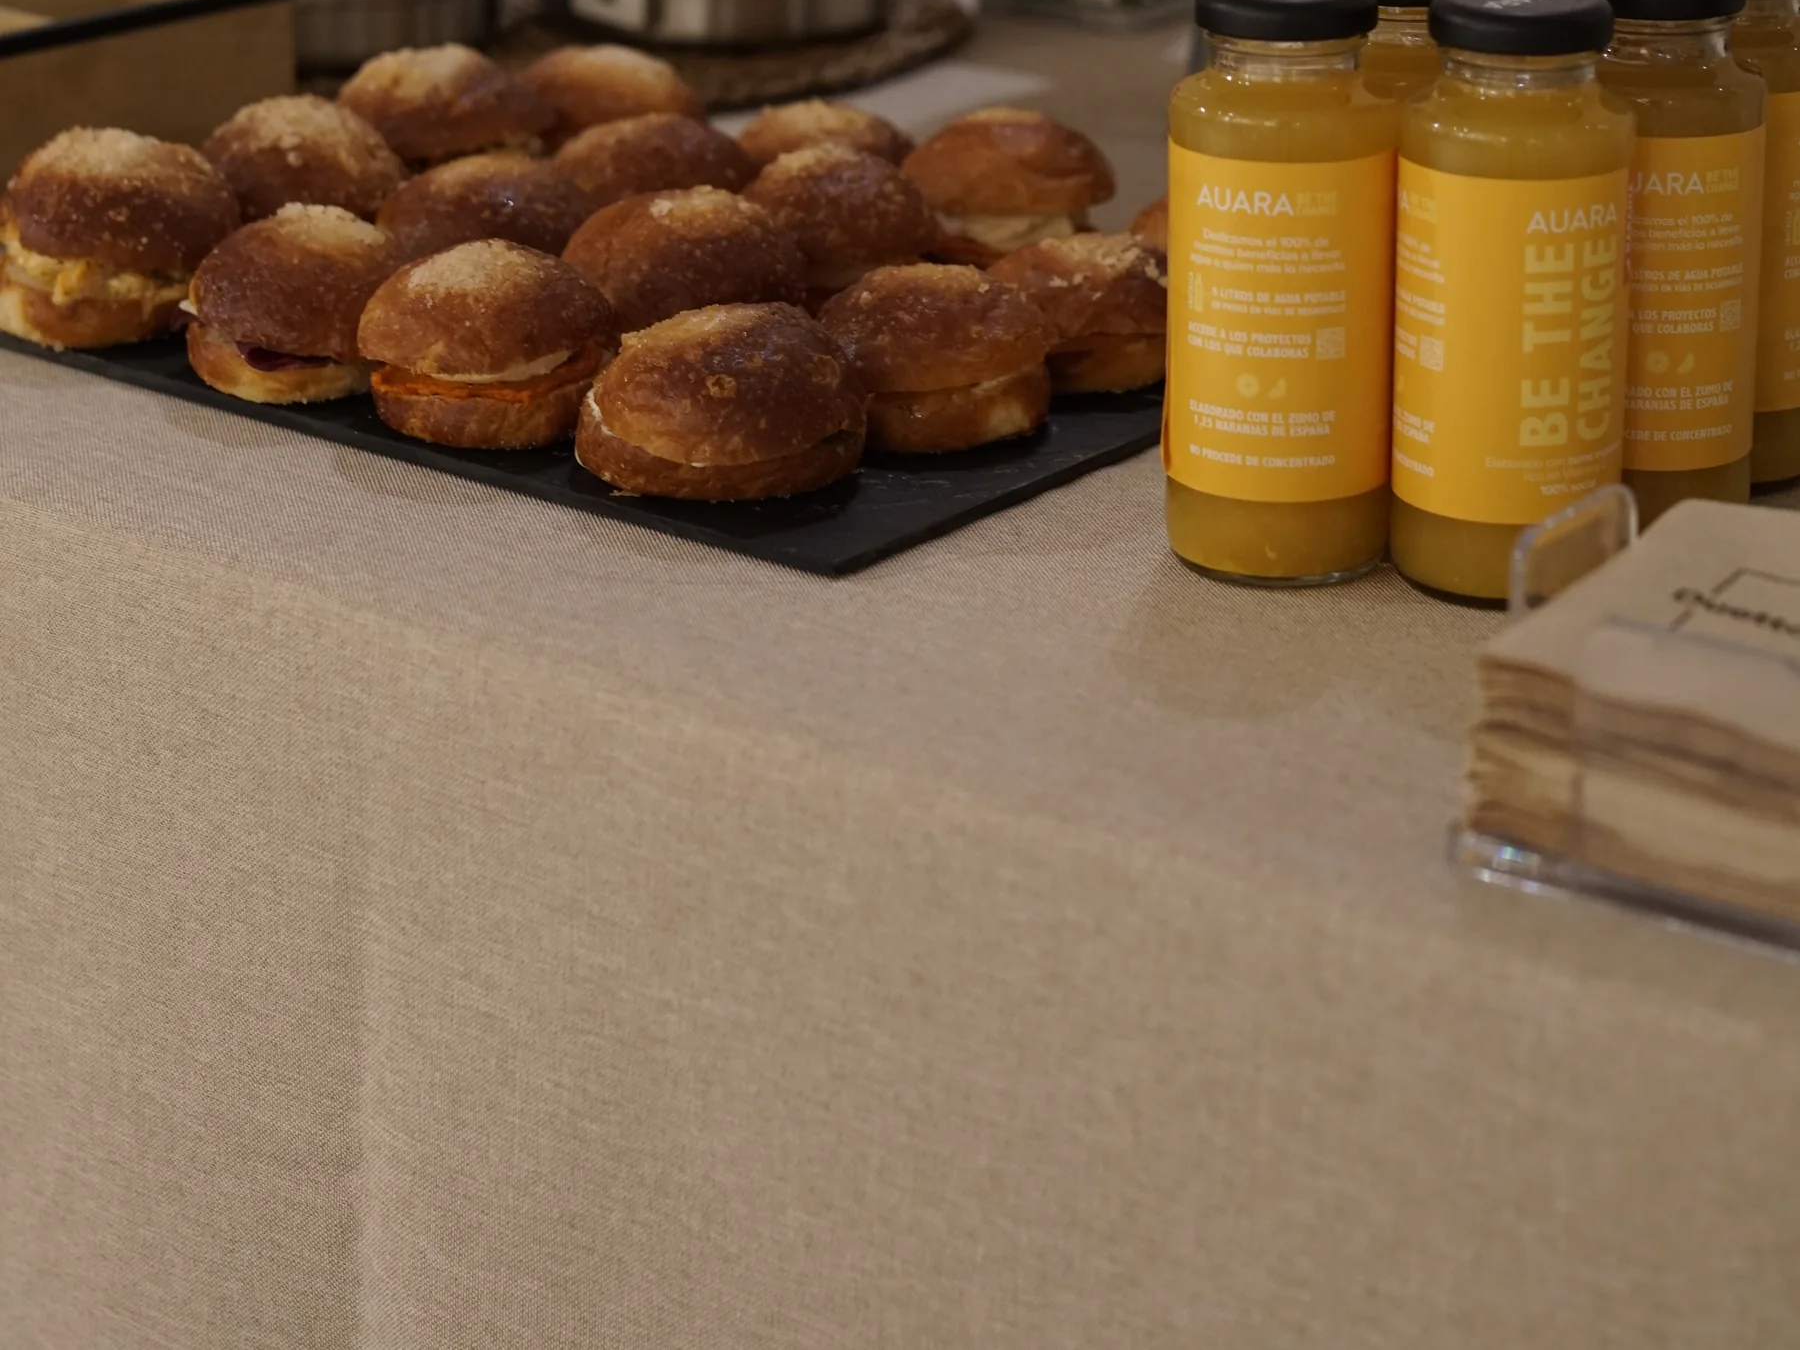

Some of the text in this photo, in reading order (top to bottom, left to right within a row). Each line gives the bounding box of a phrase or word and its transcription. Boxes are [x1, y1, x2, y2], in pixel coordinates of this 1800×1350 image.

[1631, 171, 1705, 195] UARA
[1196, 183, 1294, 217] AUARA
[1527, 203, 1618, 235] AUARA
[1649, 228, 1708, 240] beneficios
[1667, 270, 1682, 282] DE
[1638, 309, 1658, 321] LOS
[1661, 307, 1717, 321] PROYECTOS
[1632, 321, 1715, 335] QUE COLABORAS
[1251, 332, 1312, 345] PROYECTOS
[1519, 242, 1574, 447] BE THE
[1576, 235, 1619, 441] CHANGE
[1246, 346, 1309, 358] COLABORAS
[1655, 386, 1677, 398] CON
[1680, 386, 1693, 398] EL
[1695, 383, 1721, 398] ZUMO
[1722, 380, 1734, 392] DE
[1189, 399, 1336, 424] ELABORADO CON EL ZUMO DE
[1680, 399, 1694, 411] DE
[1215, 418, 1268, 437] NARANJAS
[1271, 425, 1286, 437] DE
[1653, 430, 1668, 442] DE
[1669, 423, 1732, 441] CONCENTRADO
[1202, 447, 1243, 466] PROCEDE
[1245, 455, 1260, 467] DE
[1261, 455, 1336, 468] CONCENTRADO
